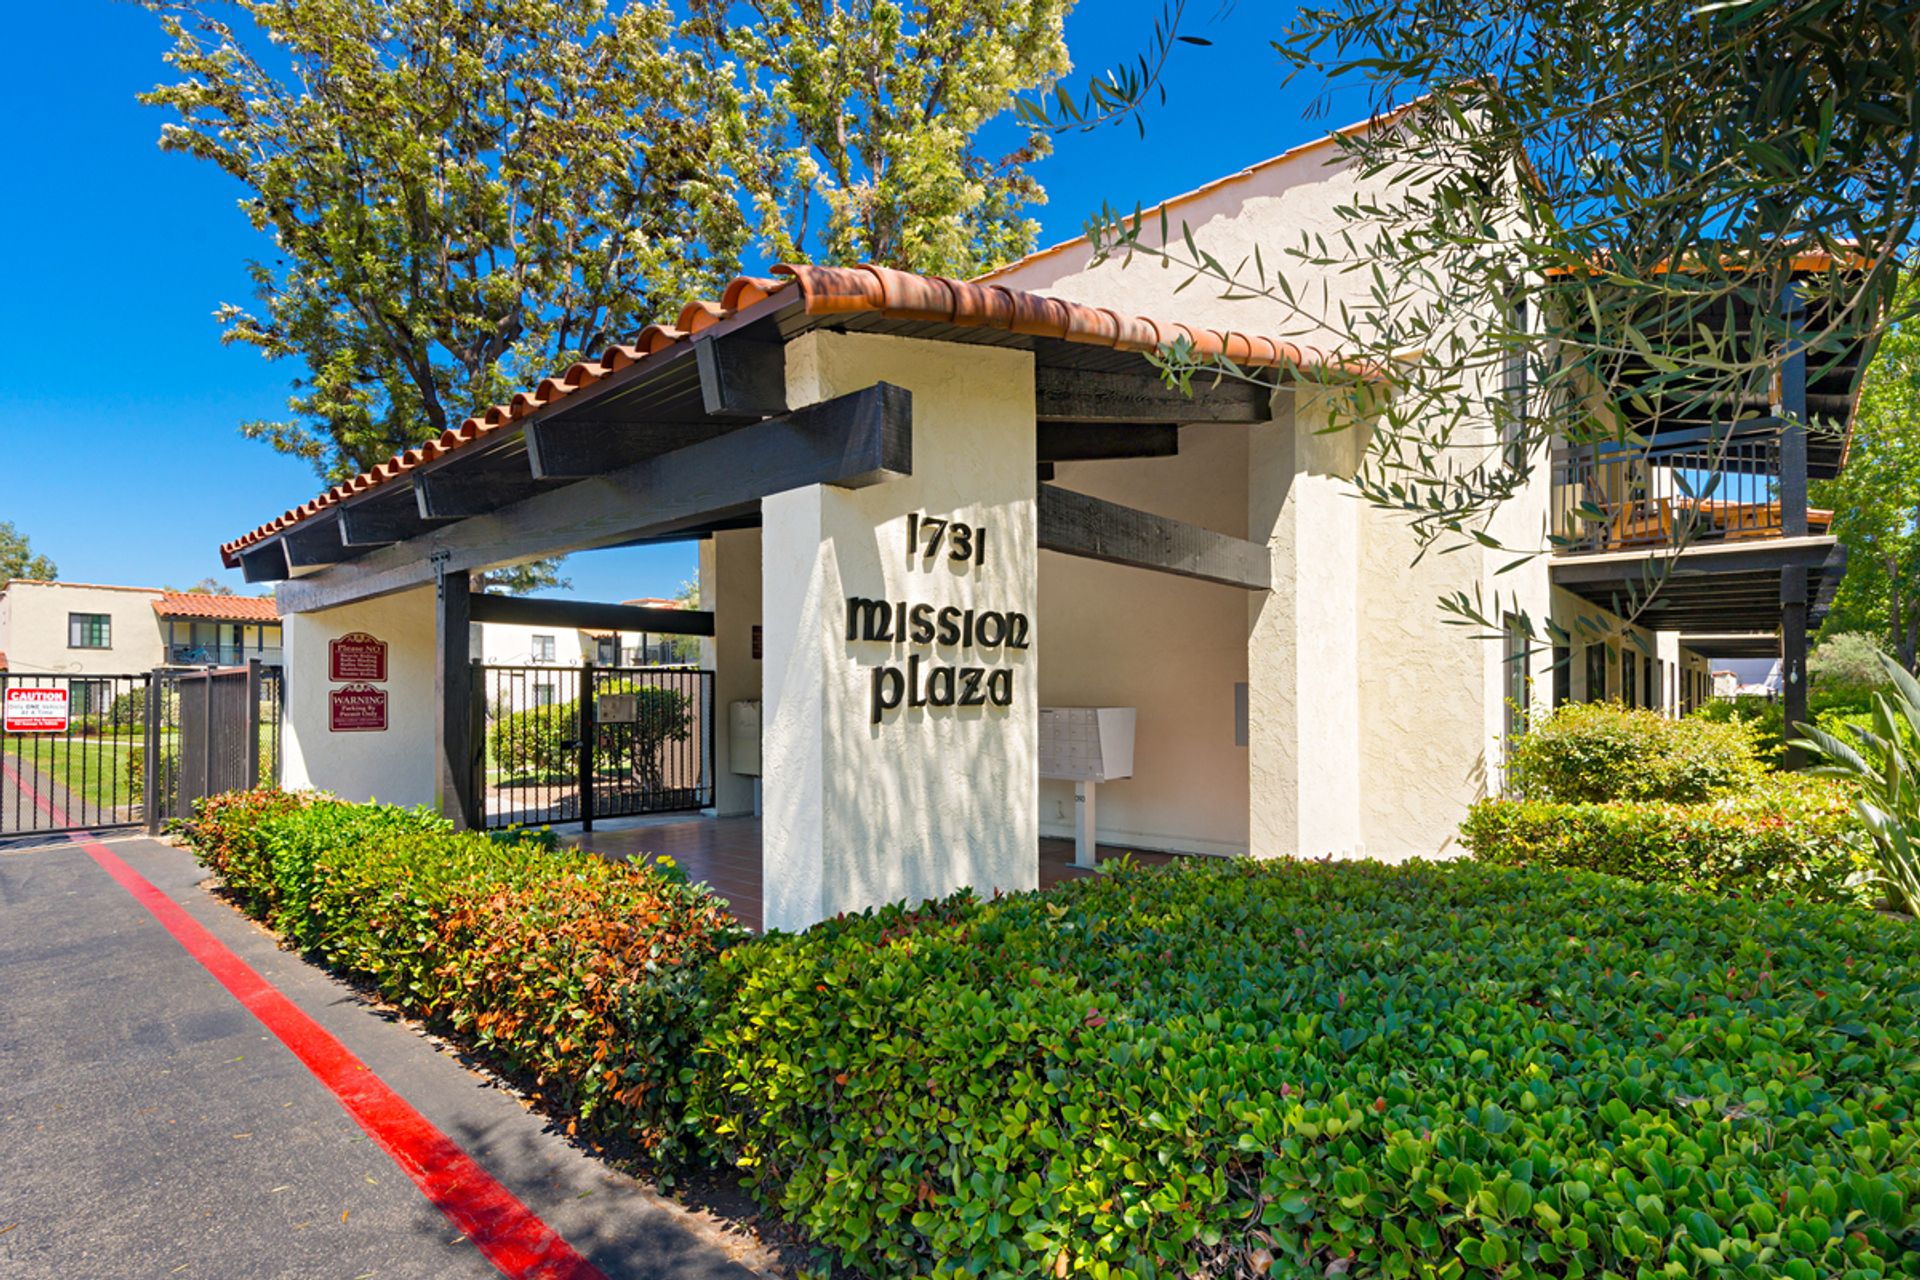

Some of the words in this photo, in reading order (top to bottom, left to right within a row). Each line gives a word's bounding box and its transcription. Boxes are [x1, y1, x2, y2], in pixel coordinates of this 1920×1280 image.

[907, 513, 986, 566] 1731
[11, 691, 63, 701] CAUTION
[334, 696, 384, 704] WARNING
[871, 654, 1013, 724] plaza
